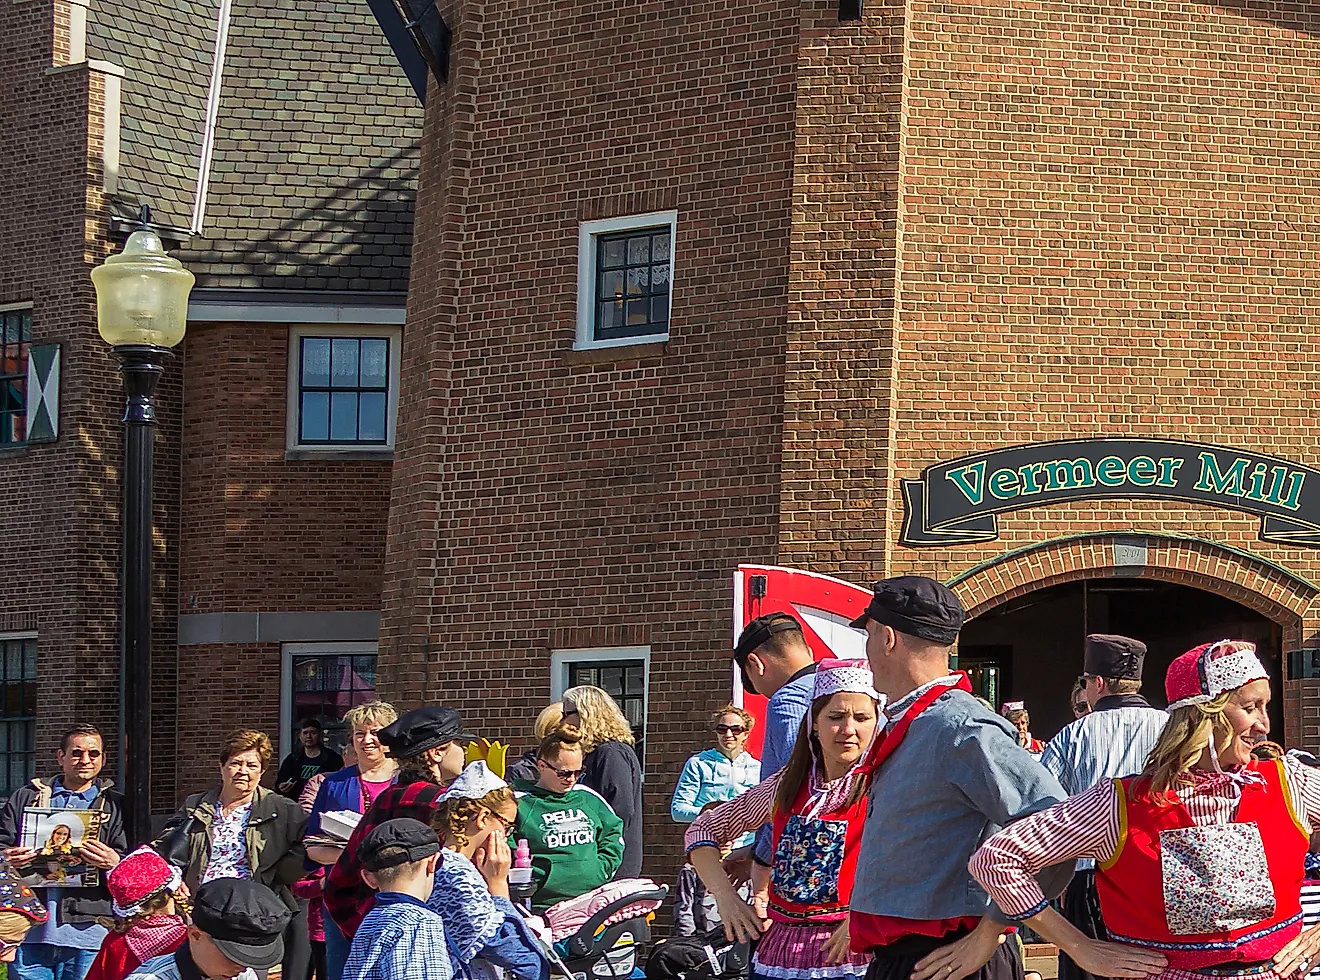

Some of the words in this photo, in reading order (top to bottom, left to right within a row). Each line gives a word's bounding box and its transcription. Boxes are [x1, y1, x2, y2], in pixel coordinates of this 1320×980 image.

[946, 453, 1185, 505] Vermeer
[1197, 452, 1307, 511] Mill
[541, 809, 588, 825] PELLA
[547, 831, 594, 849] DUTCH
